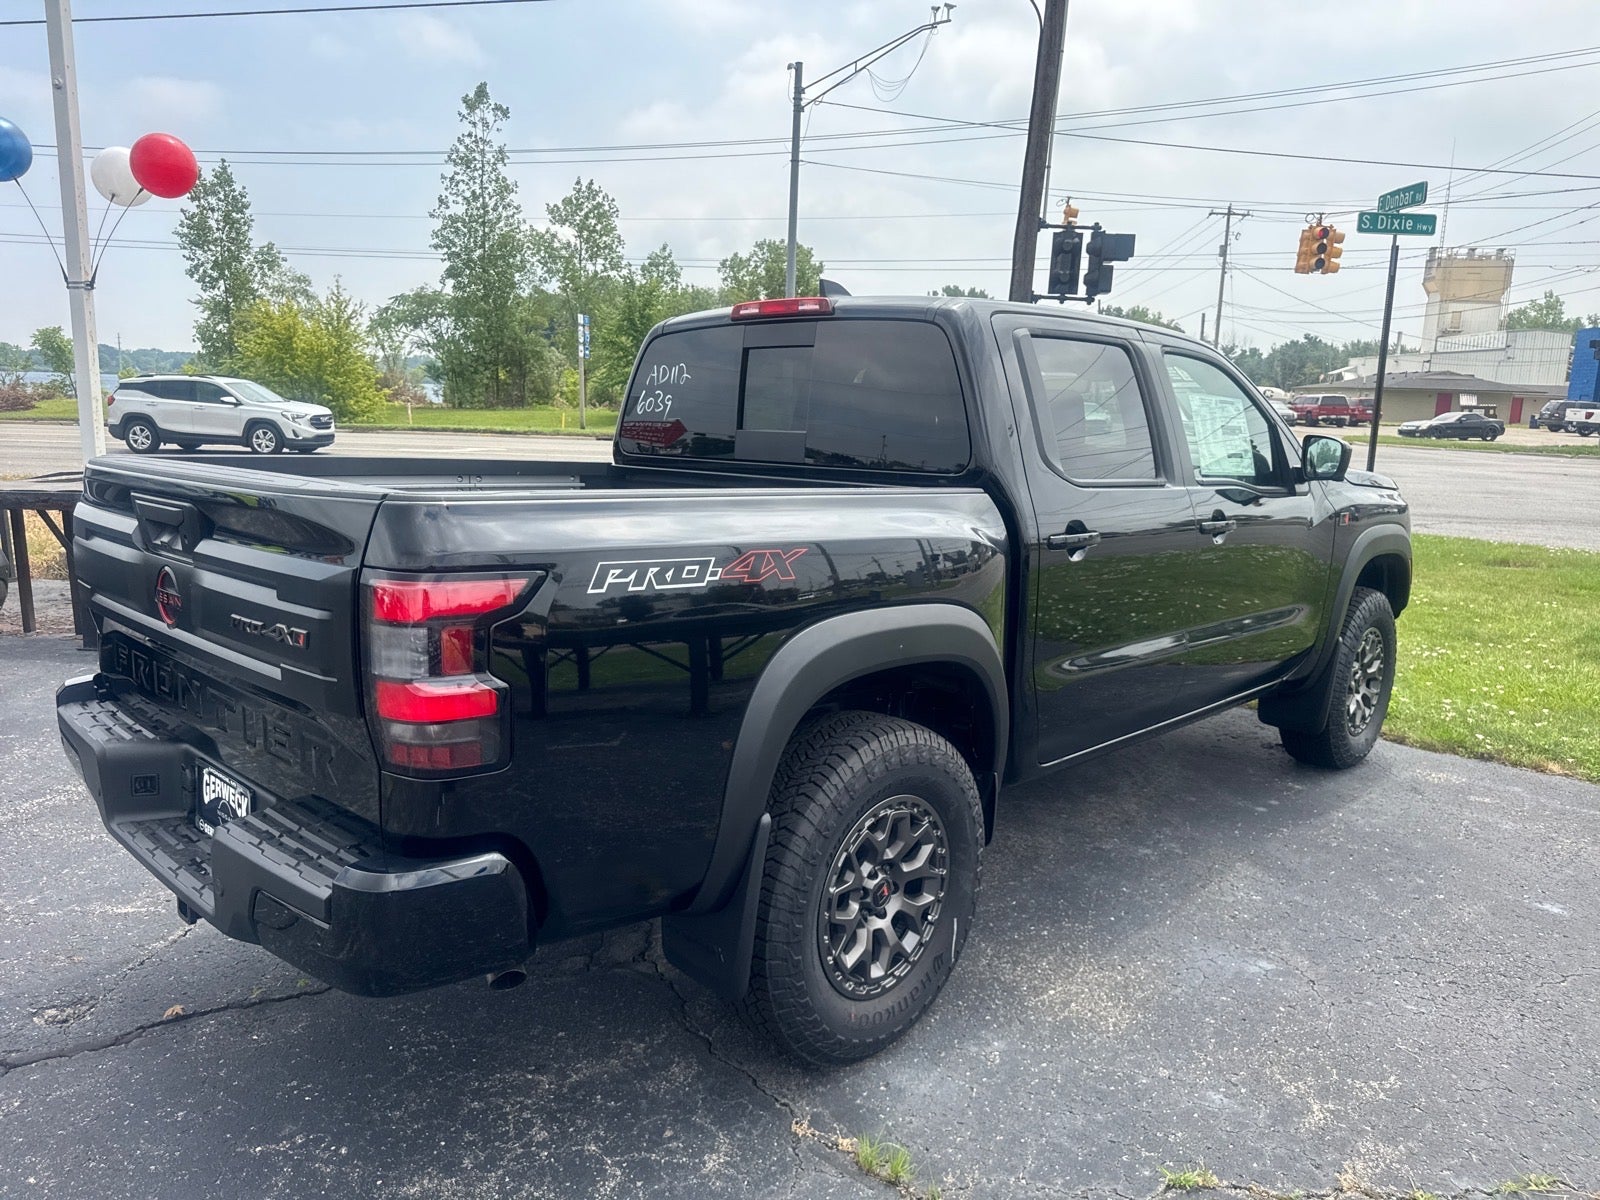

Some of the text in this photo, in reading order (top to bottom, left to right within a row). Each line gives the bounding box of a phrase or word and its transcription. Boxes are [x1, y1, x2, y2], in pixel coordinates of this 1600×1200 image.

[1385, 191, 1414, 211] Dunbar
[1361, 214, 1433, 232] S. Dixie Hwy
[637, 390, 673, 420] 6039
[114, 641, 339, 788] FRONTIER
[203, 772, 248, 818] GERWECK
